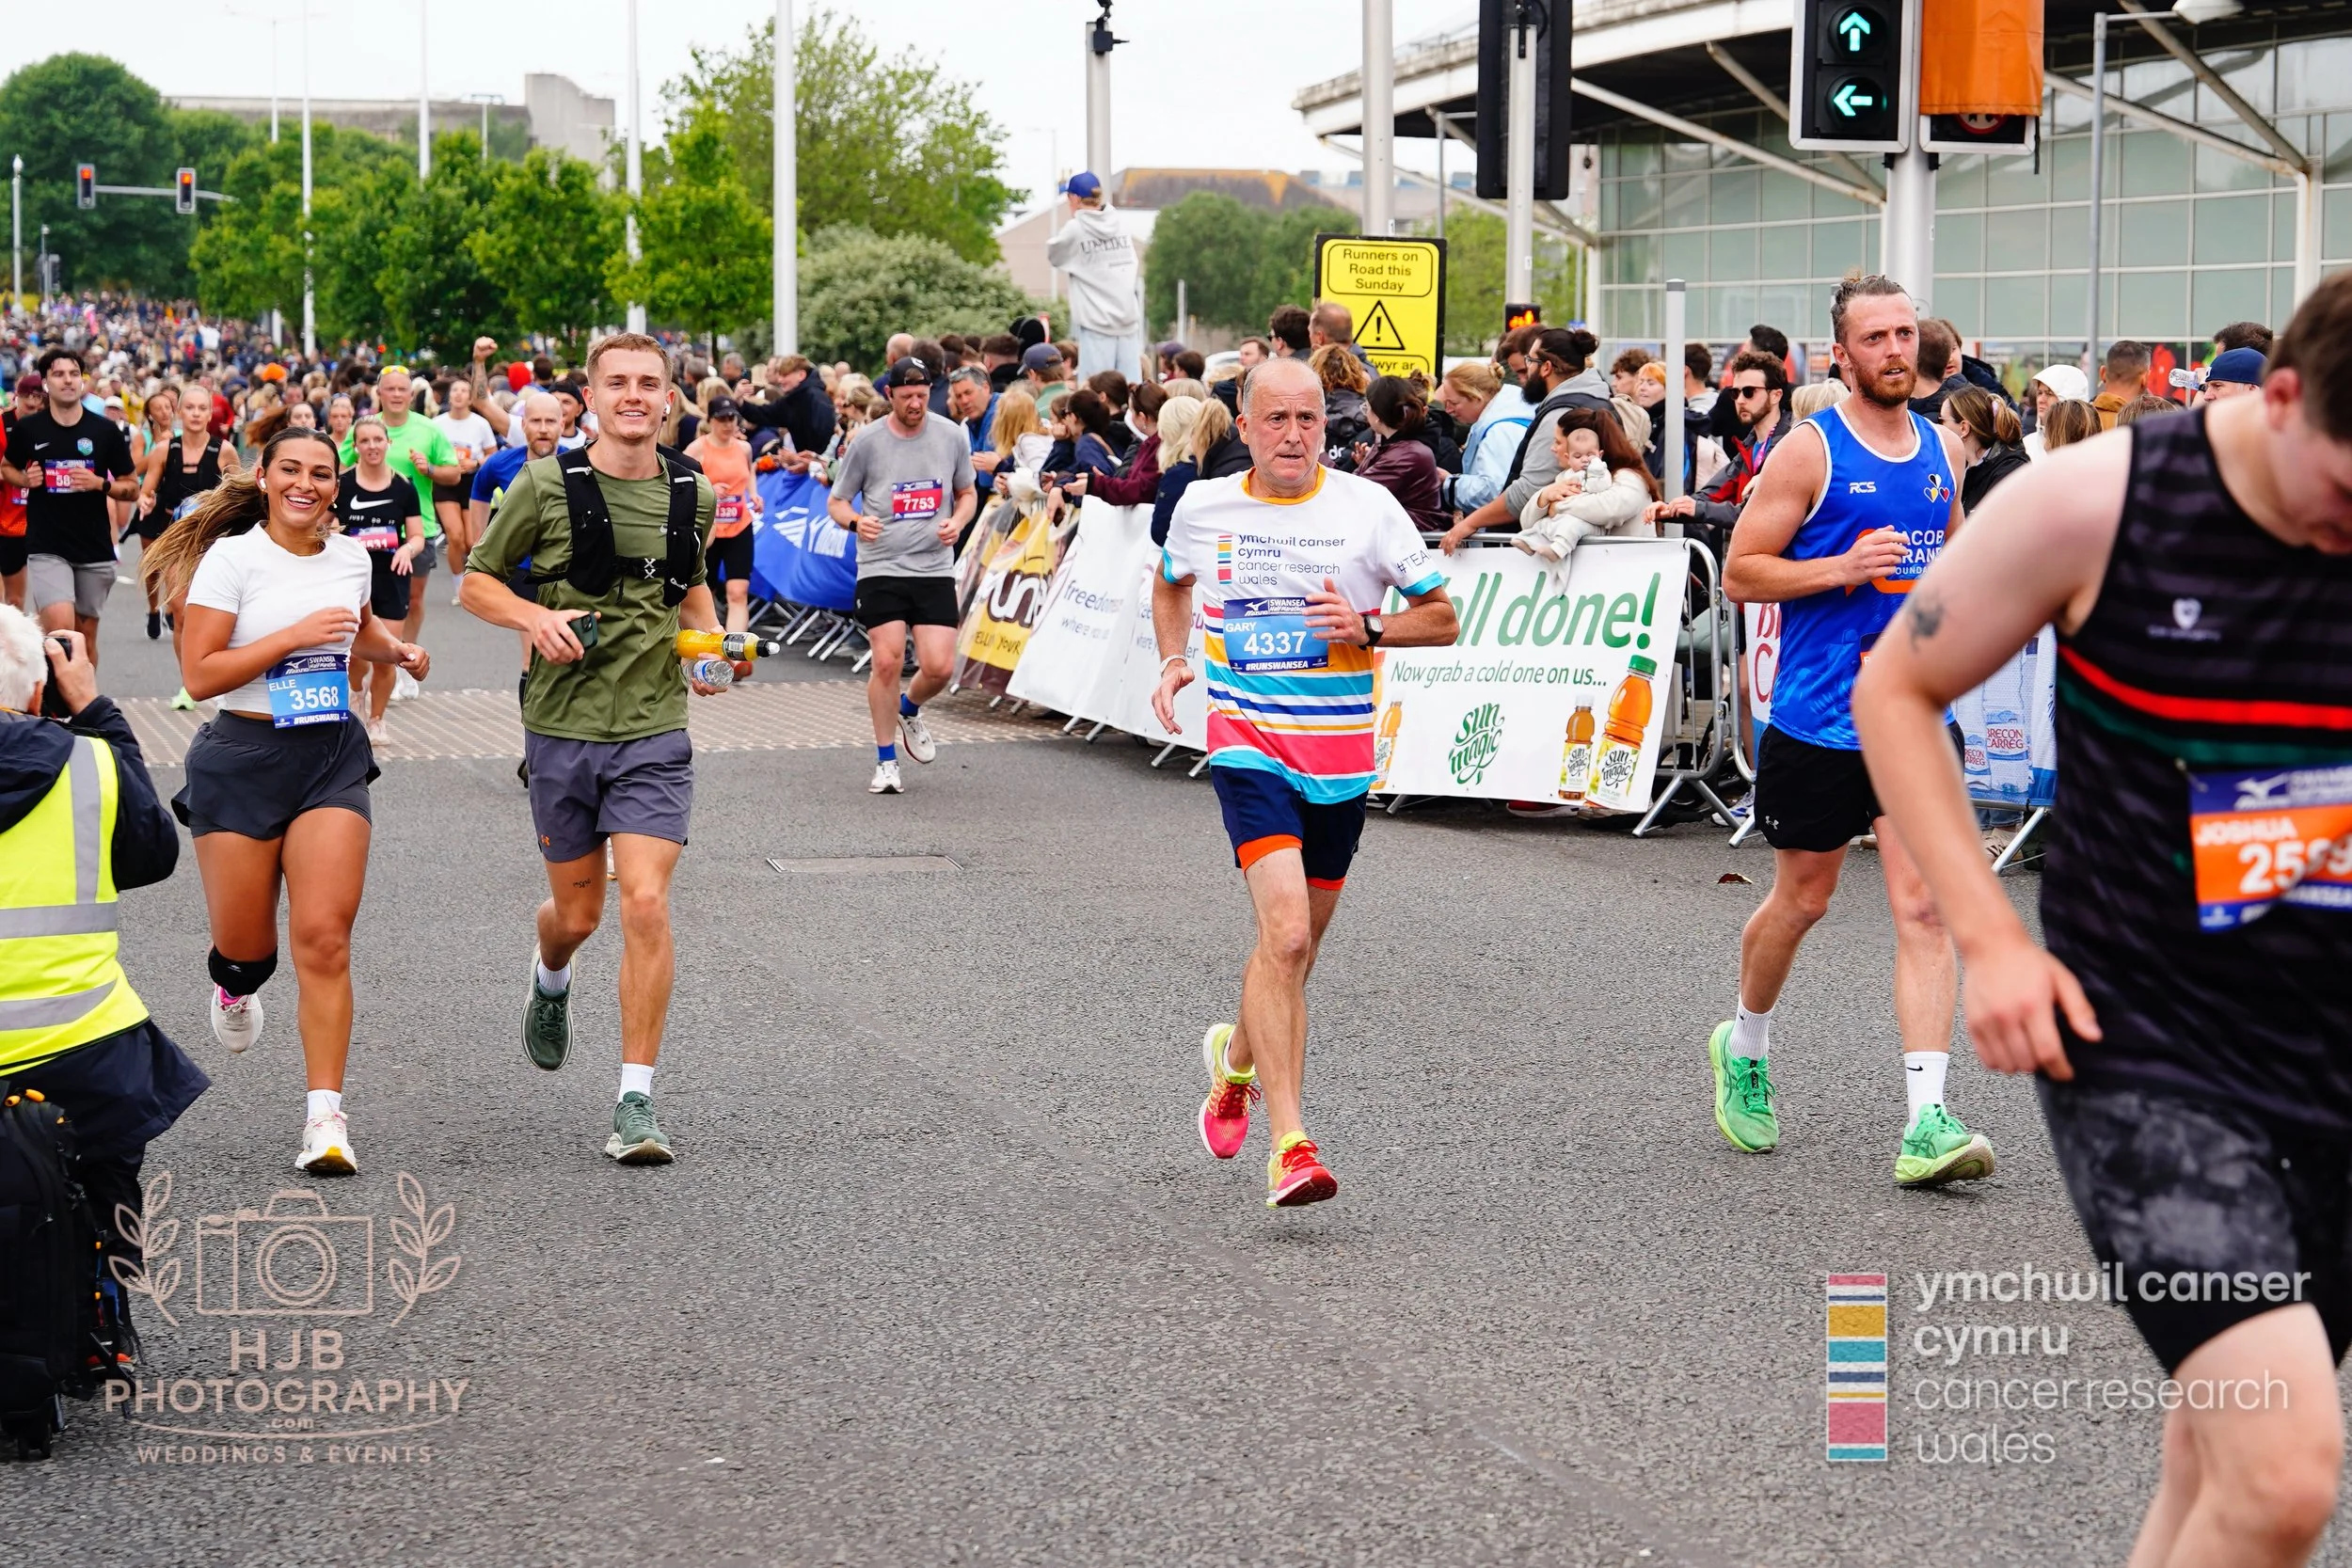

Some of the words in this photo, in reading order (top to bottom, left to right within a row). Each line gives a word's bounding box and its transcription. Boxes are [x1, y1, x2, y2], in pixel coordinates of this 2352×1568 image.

[1343, 248, 1398, 261] Runners
[1403, 252, 1419, 261] on
[1349, 263, 1384, 276] Road
[1388, 265, 1412, 277] this
[1356, 278, 1405, 293] Sunday
[1372, 358, 1397, 372] wyr
[1402, 361, 1415, 371] ar
[1849, 481, 1877, 494] RCS
[903, 497, 935, 511] 7753
[1238, 534, 1296, 546] ymchwil
[1299, 538, 1345, 547] canser
[1895, 530, 1945, 546] ACOB
[1238, 547, 1281, 559] cymru
[1238, 562, 1281, 572] cancer
[1284, 562, 1341, 574] research
[1397, 549, 1431, 574] #TEA
[1239, 575, 1278, 586] wales
[1498, 571, 1661, 649] done!
[1225, 622, 1257, 633] GARY
[1244, 631, 1307, 656] 4337
[1245, 661, 1309, 672] #RUNSWANSEA
[1391, 660, 1427, 683] Now
[1426, 660, 1463, 689] grab
[1464, 669, 1474, 683] a
[1476, 660, 1514, 684] cold
[1516, 670, 1544, 685] one
[1547, 669, 1570, 685] on
[1572, 669, 1607, 688] us...
[269, 679, 297, 691] ELLE
[290, 686, 339, 711] 3568
[1454, 703, 1505, 746] sun
[1448, 726, 1503, 785] magic
[1605, 750, 1633, 767] sun
[1601, 765, 1632, 788] magic
[2195, 816, 2298, 847] JOSHUA
